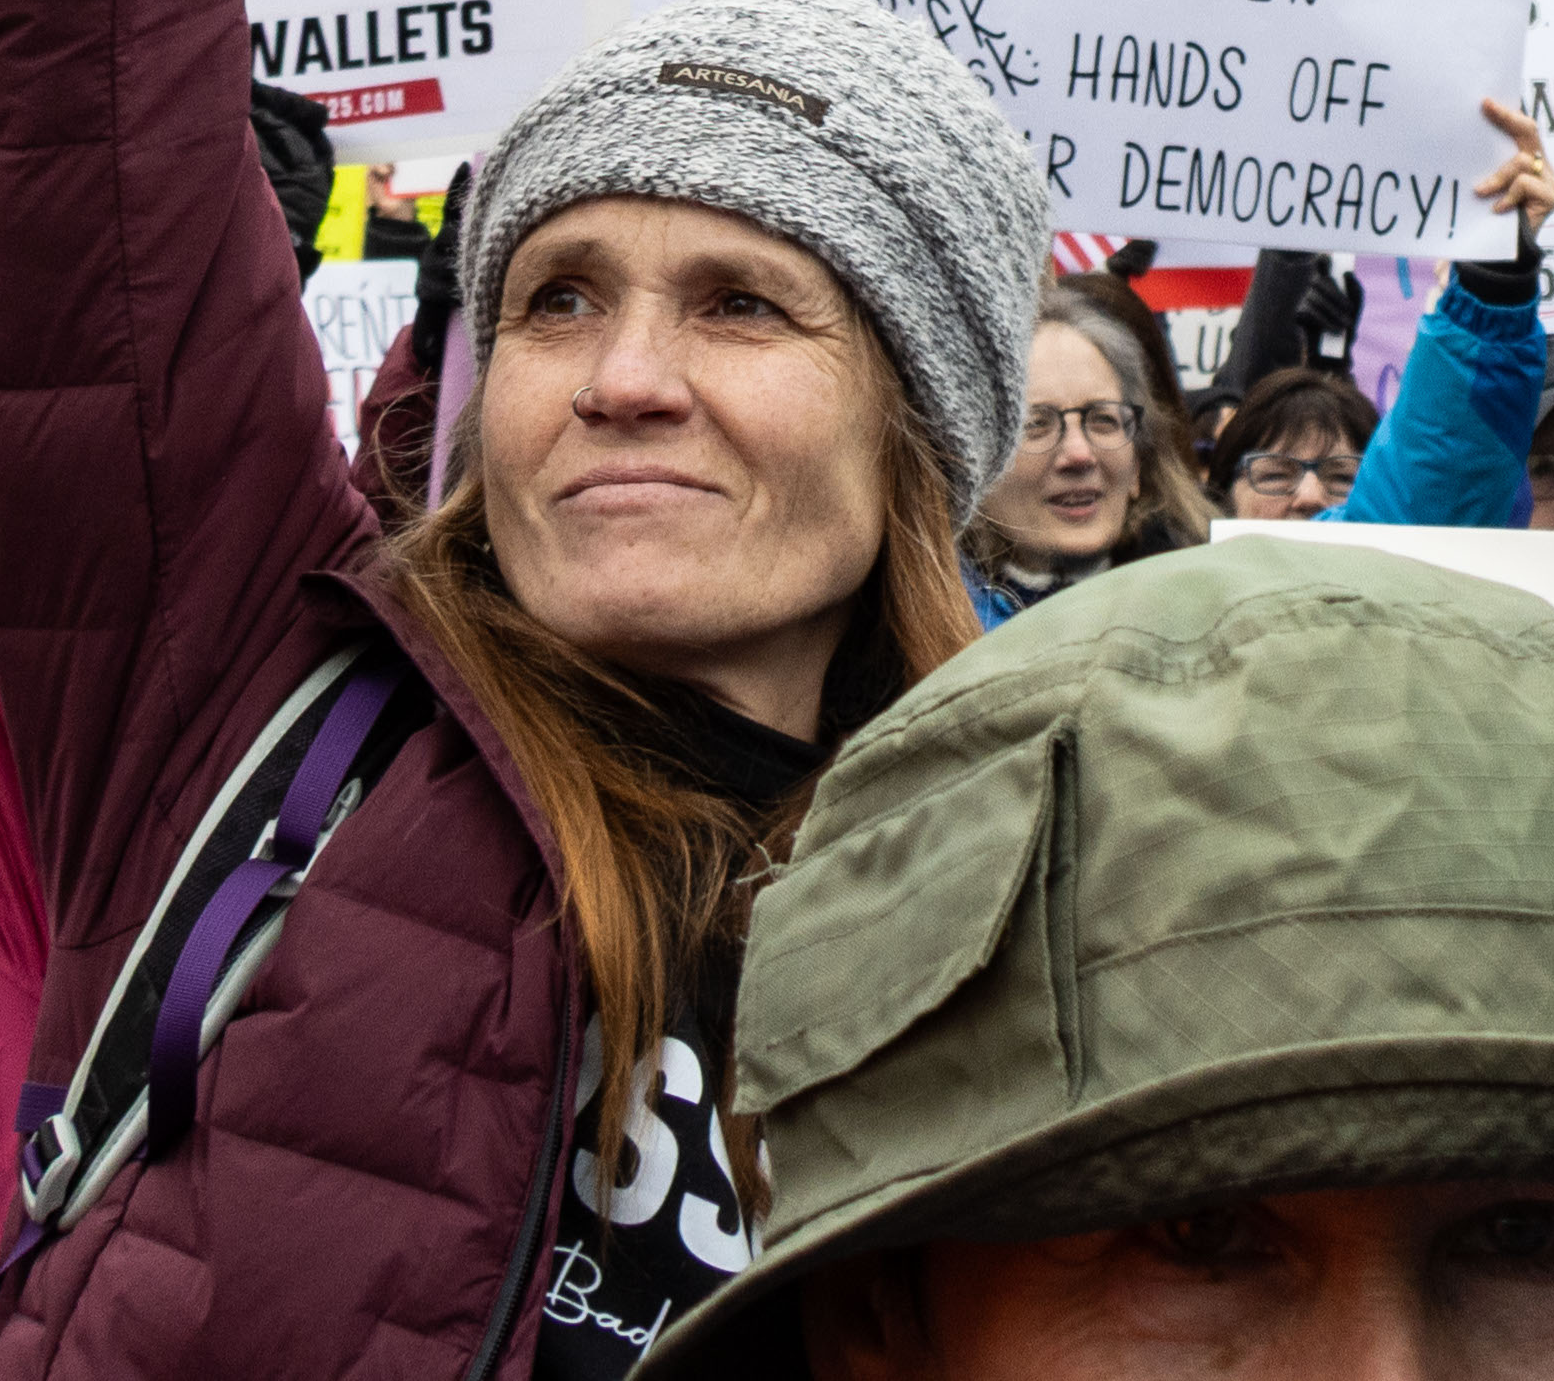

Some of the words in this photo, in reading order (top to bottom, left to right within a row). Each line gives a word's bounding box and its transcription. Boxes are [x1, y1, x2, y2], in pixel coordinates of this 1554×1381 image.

[319, 88, 406, 119] 25.COM
[673, 66, 806, 111] ARTESANIA
[1067, 33, 1247, 111] HANDS
[1289, 57, 1391, 126] OFF
[1119, 141, 1461, 239] DEMOCRACY!
[542, 1239, 673, 1362] Bad
